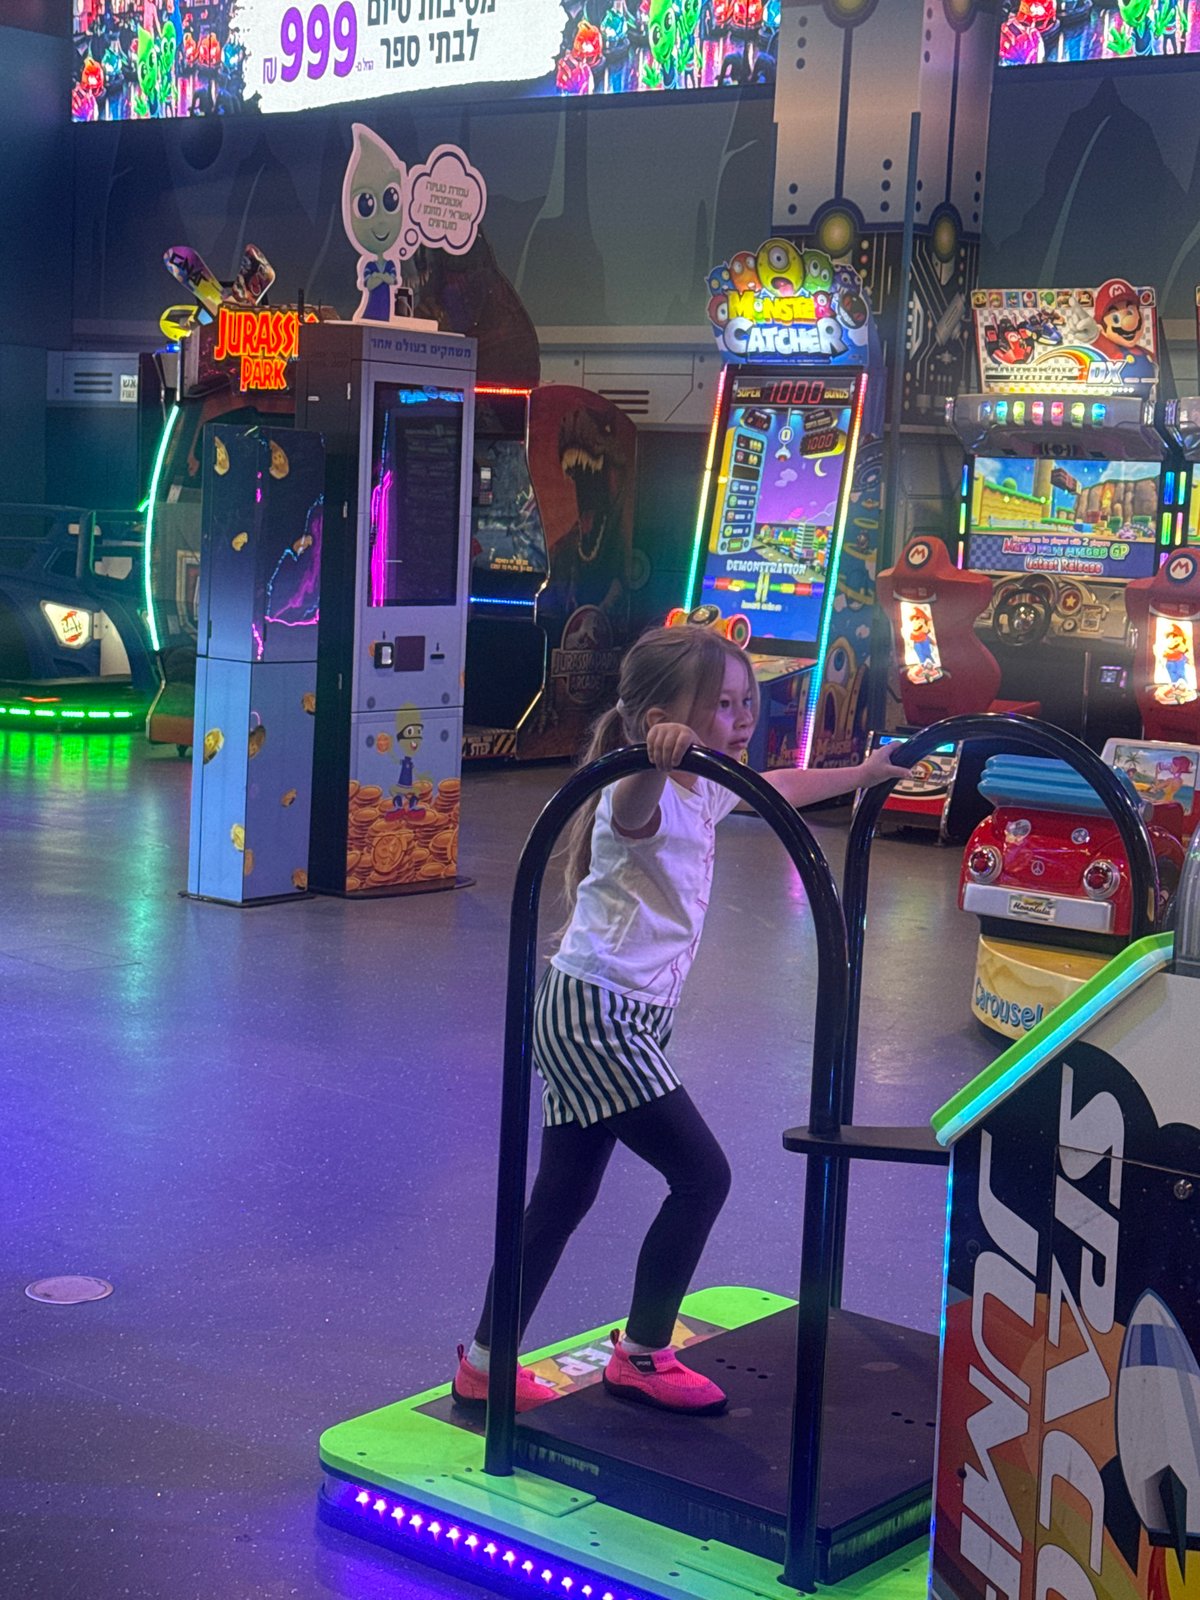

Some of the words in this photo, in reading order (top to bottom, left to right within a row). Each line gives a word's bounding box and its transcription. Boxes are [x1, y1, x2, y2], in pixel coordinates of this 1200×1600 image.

[418, 0, 495, 21] סבות
[280, 1, 358, 83] 999
[380, 34, 420, 69] ספר
[428, 18, 480, 64] לבתי
[727, 289, 834, 325] MONSTER
[214, 308, 300, 361] JURASSI
[370, 337, 392, 350] אחר
[723, 316, 849, 358] CATCHER
[395, 338, 427, 354] בעולם
[430, 344, 472, 359] משחקים
[122, 378, 136, 389] אש
[240, 355, 287, 392] PARK
[1087, 361, 1124, 385] DX
[769, 380, 825, 404] 1000
[807, 432, 834, 450] 1000
[1083, 537, 1089, 546] 2
[1110, 543, 1130, 560] GP
[1025, 556, 1060, 572] Latest
[1060, 558, 1104, 575] Release
[470, 742, 490, 756] STEP
[975, 977, 1044, 1031] Carousel
